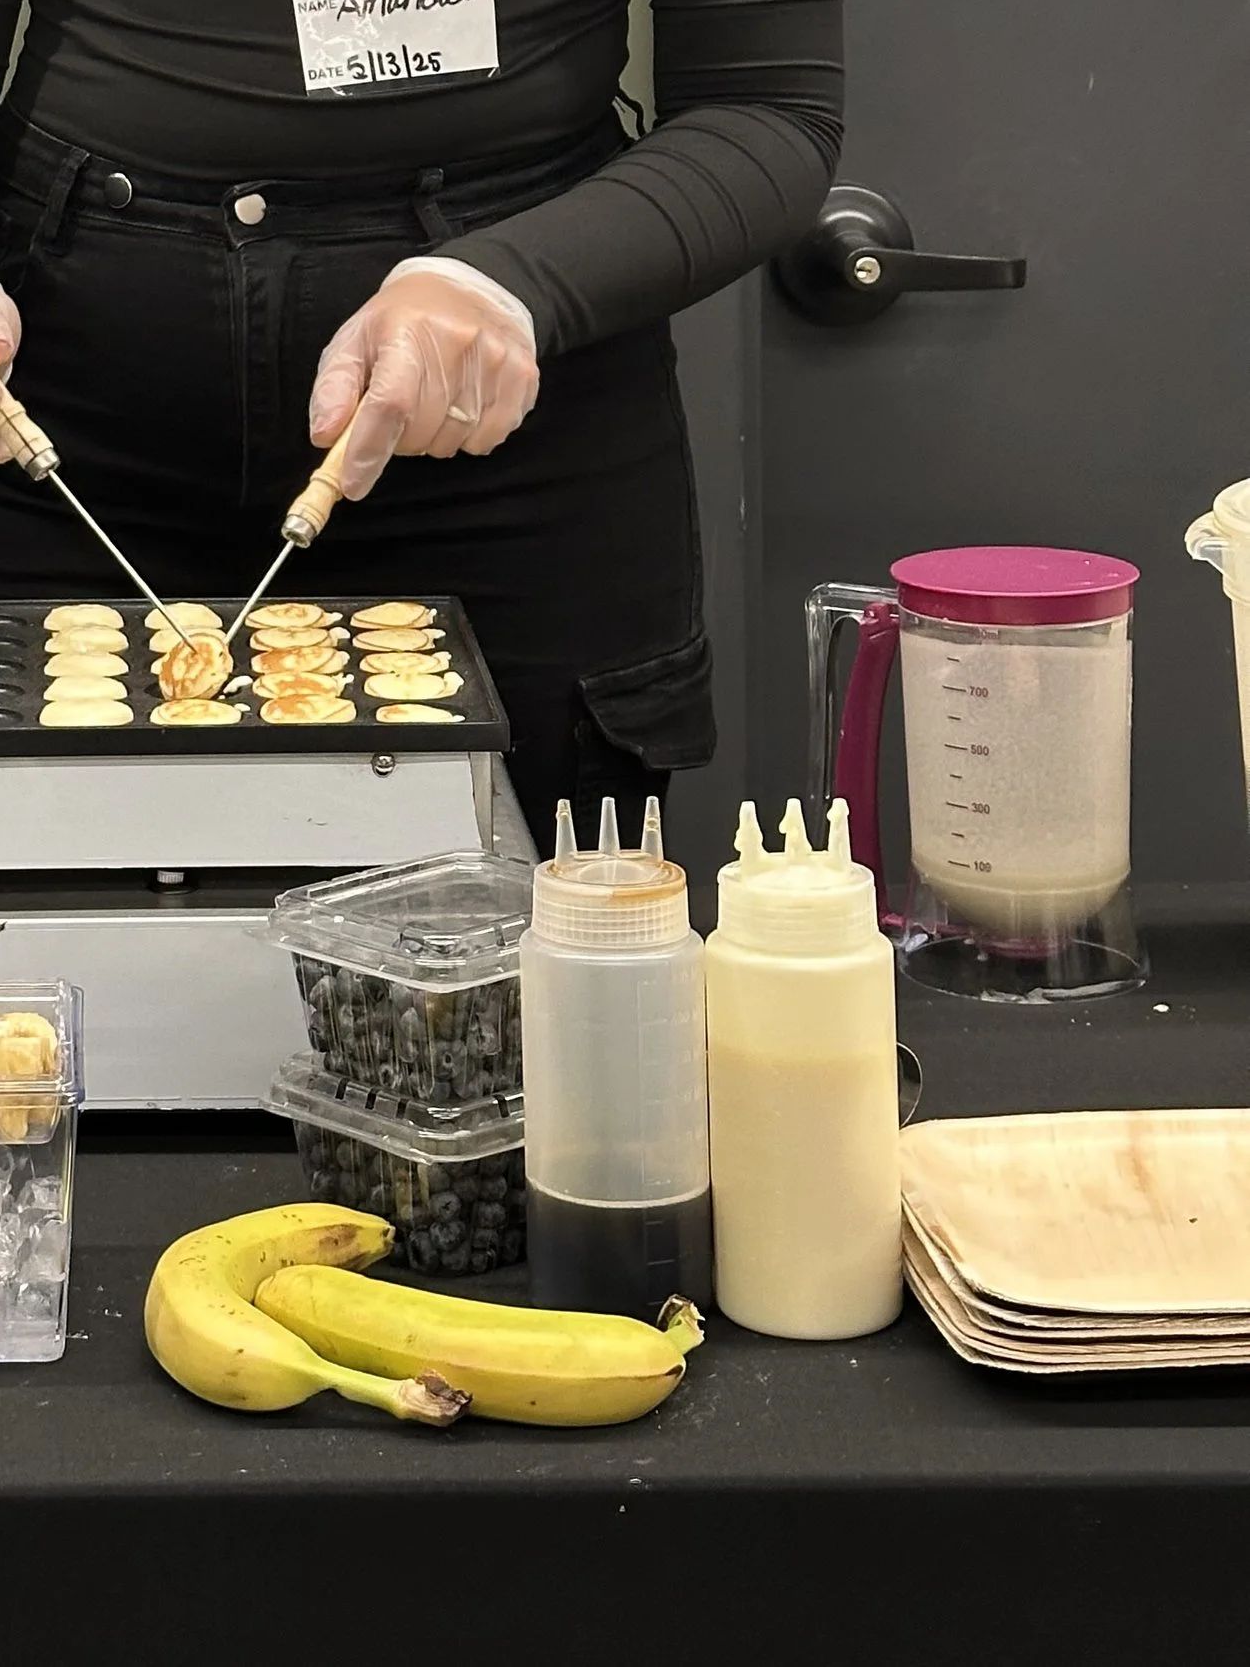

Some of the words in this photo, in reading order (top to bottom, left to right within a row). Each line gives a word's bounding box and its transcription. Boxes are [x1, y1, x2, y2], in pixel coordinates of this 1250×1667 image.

[307, 66, 344, 81] DATE
[969, 686, 989, 698] 700
[970, 743, 990, 756] 500
[971, 801, 991, 815] 300
[973, 860, 992, 873] 100
